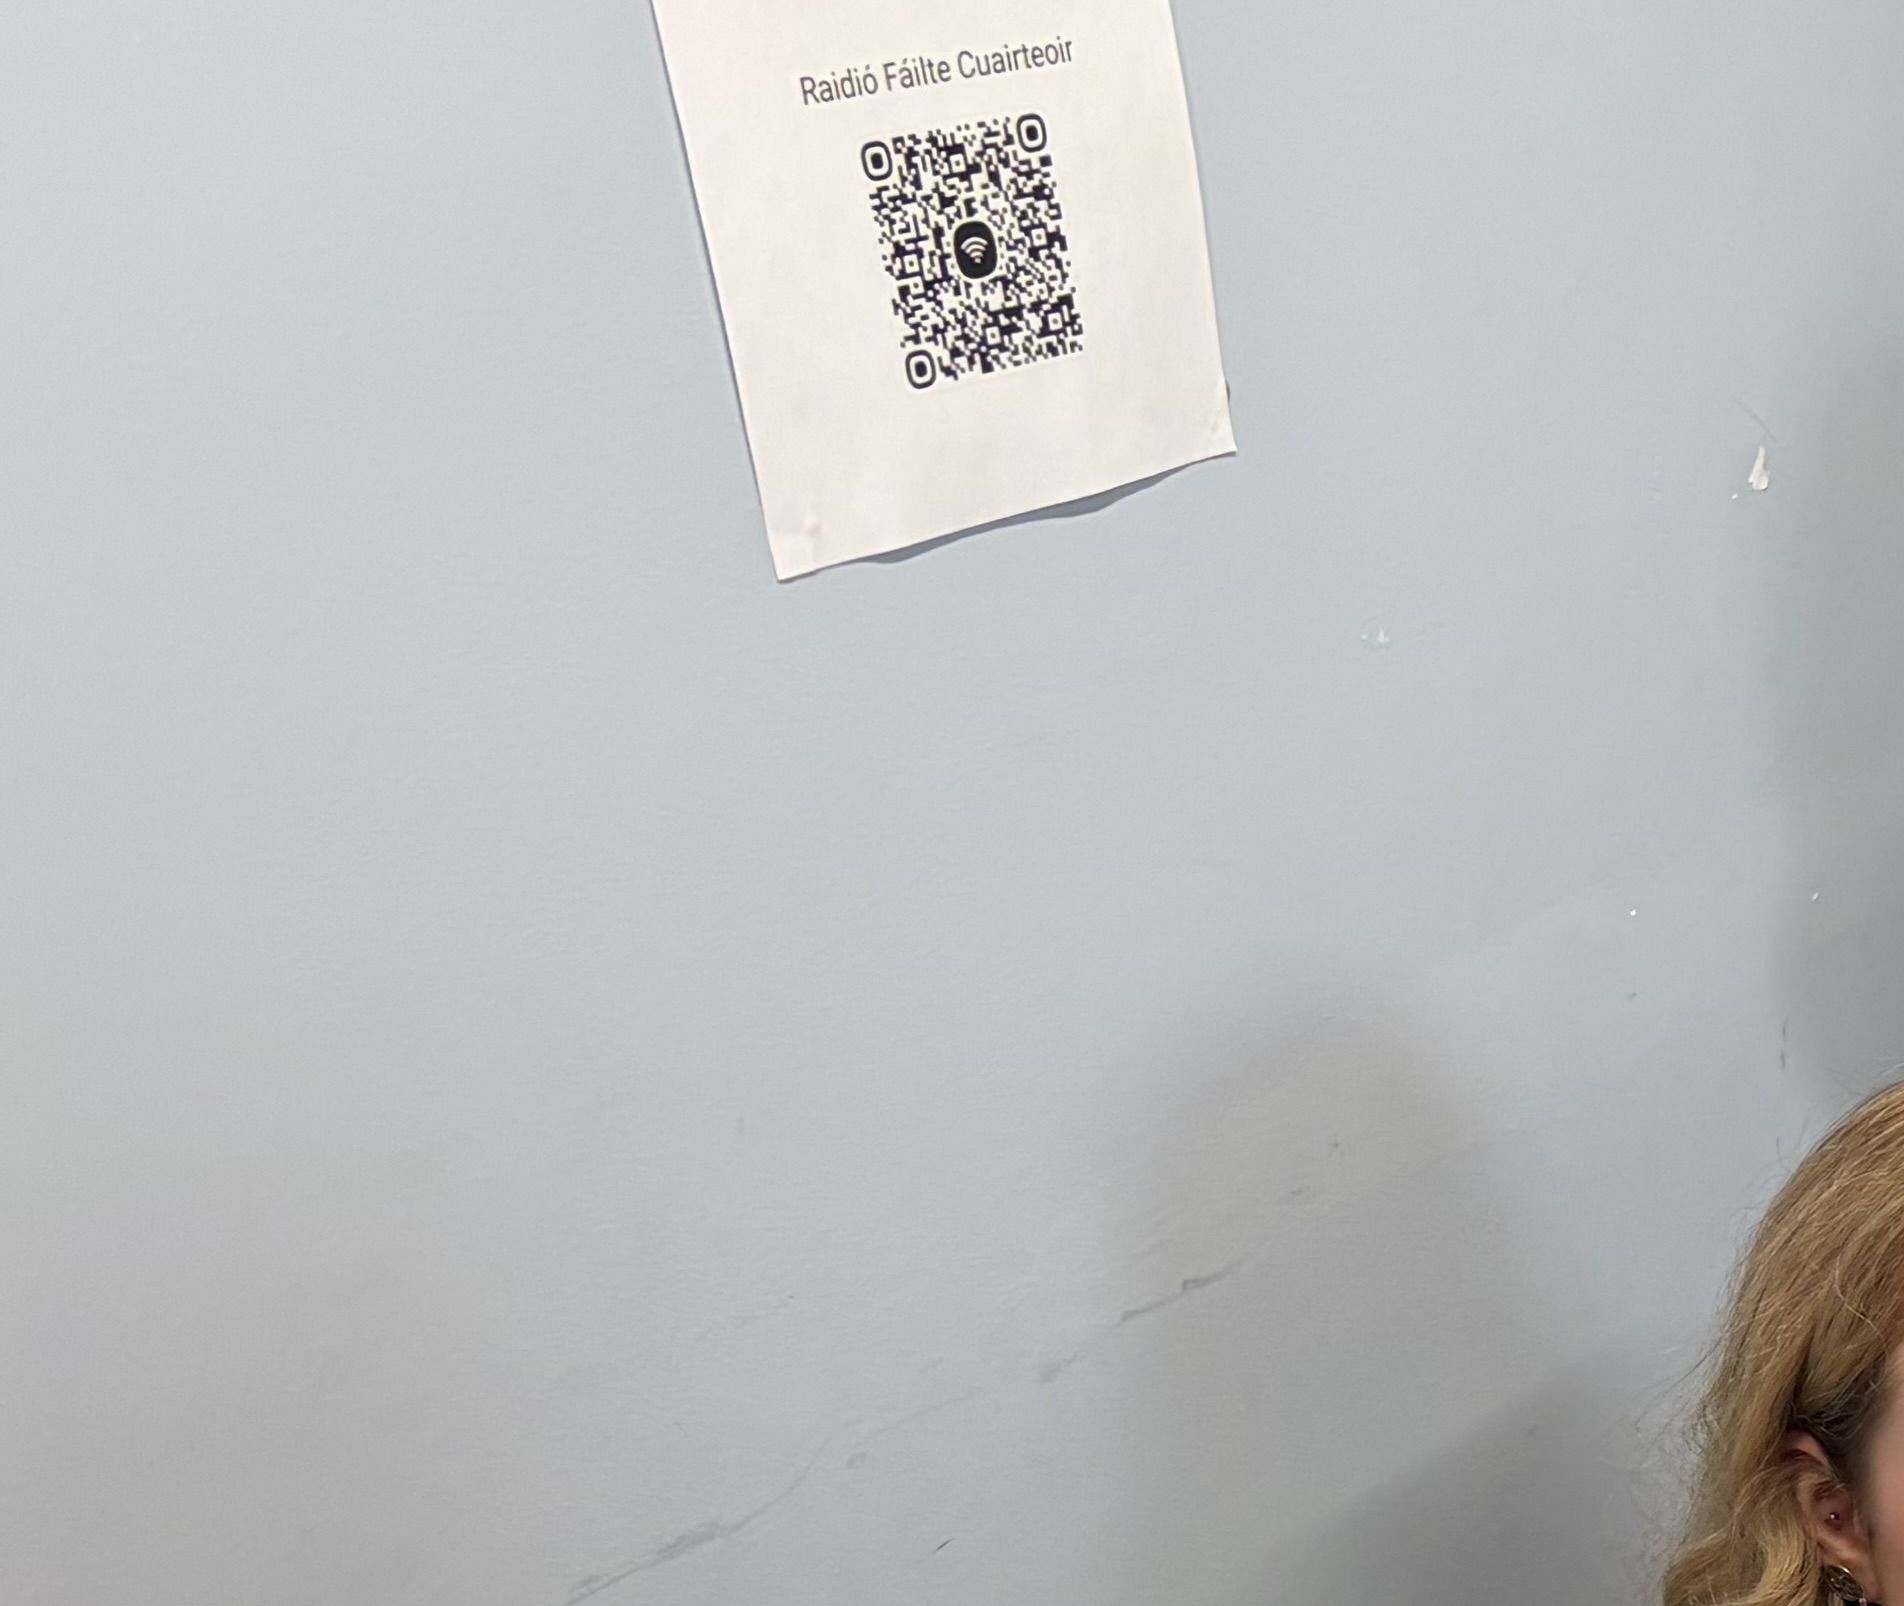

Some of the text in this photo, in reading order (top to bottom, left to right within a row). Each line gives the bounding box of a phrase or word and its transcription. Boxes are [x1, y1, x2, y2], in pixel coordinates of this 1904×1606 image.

[799, 35, 1074, 105] Raidió Fáilte Cuairteoir
